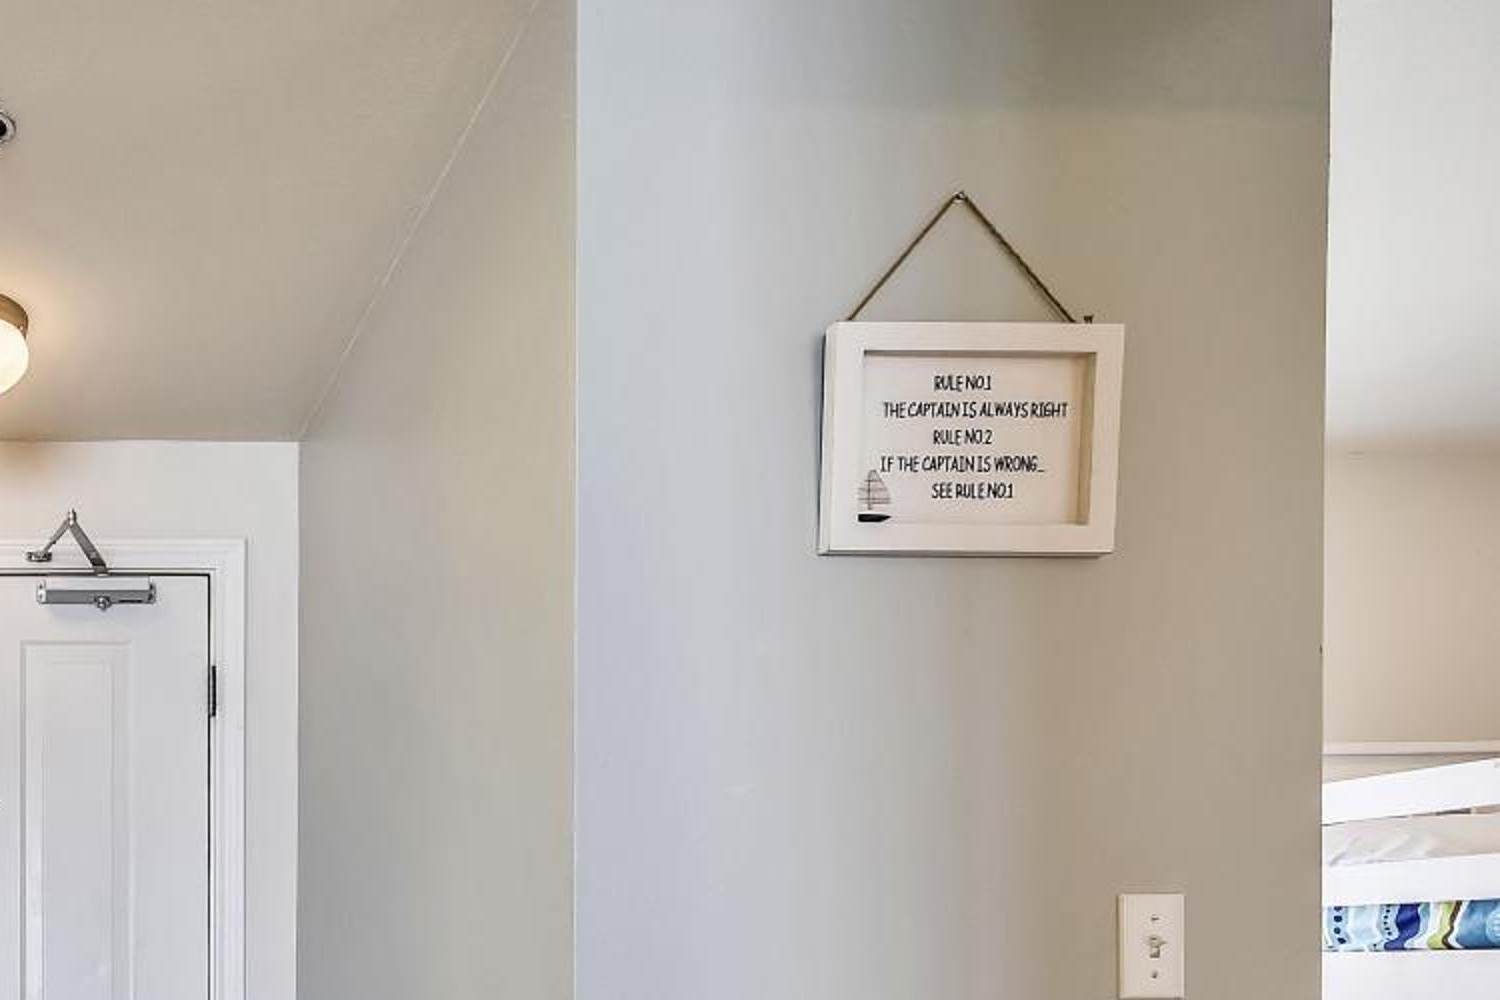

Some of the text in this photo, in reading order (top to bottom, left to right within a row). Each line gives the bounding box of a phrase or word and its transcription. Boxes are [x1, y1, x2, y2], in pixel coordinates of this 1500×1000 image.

[933, 375, 963, 392] RULE
[883, 401, 1068, 418] THE CAPTAIN IS ALWAYS RIGHT
[933, 429, 961, 446] RULE
[880, 456, 895, 472] IF
[897, 455, 920, 472] THE
[921, 455, 975, 472] CAPTAIN
[976, 455, 991, 472] IS
[931, 482, 953, 499] SEE
[955, 482, 985, 499] RULE
